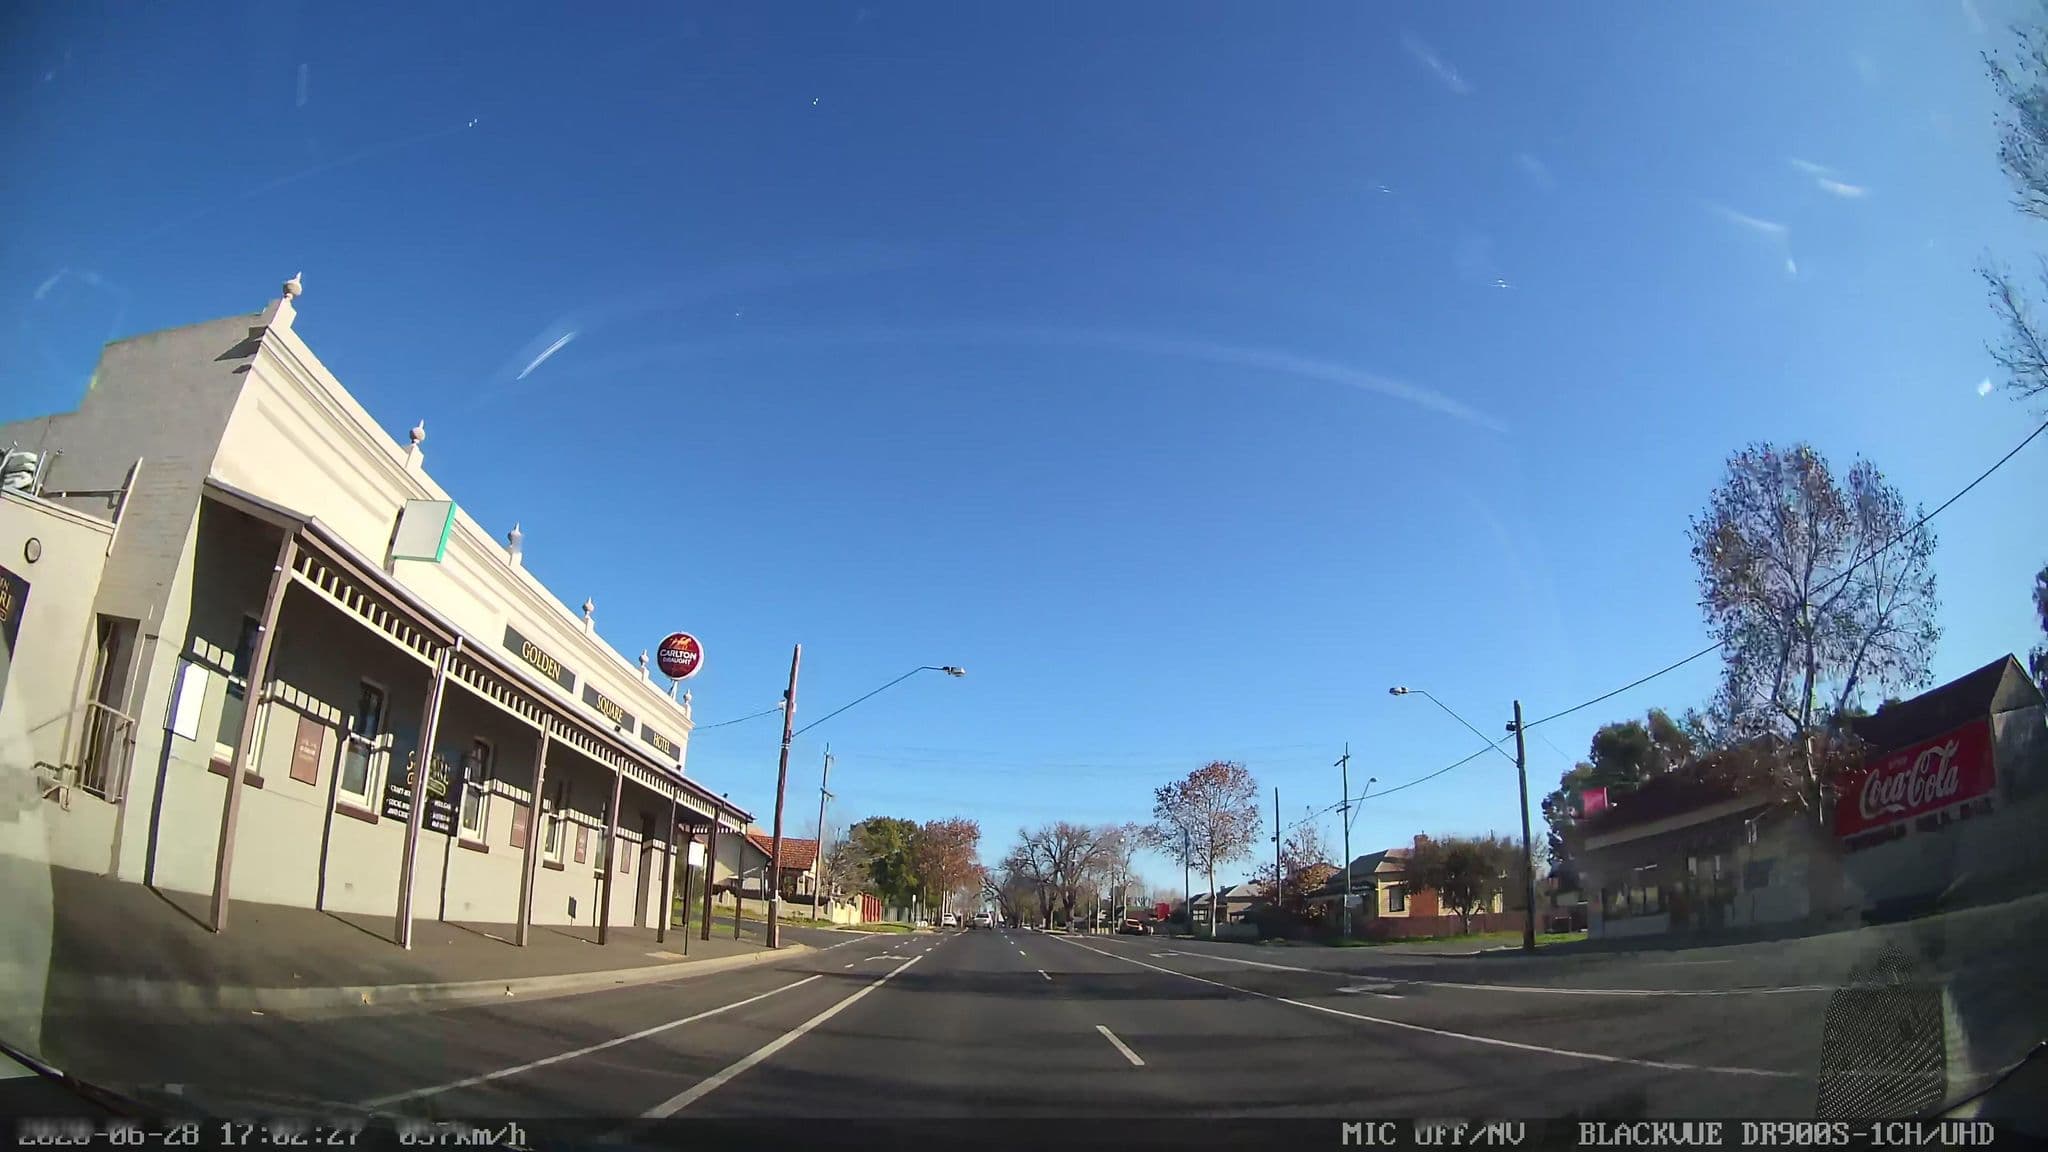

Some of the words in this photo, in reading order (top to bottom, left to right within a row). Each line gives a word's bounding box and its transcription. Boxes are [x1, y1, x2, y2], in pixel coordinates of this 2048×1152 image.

[660, 649, 697, 660] CARLTON
[522, 640, 561, 681] GOLDEN
[596, 694, 624, 723] SQUARE
[653, 732, 670, 754] HOTEL
